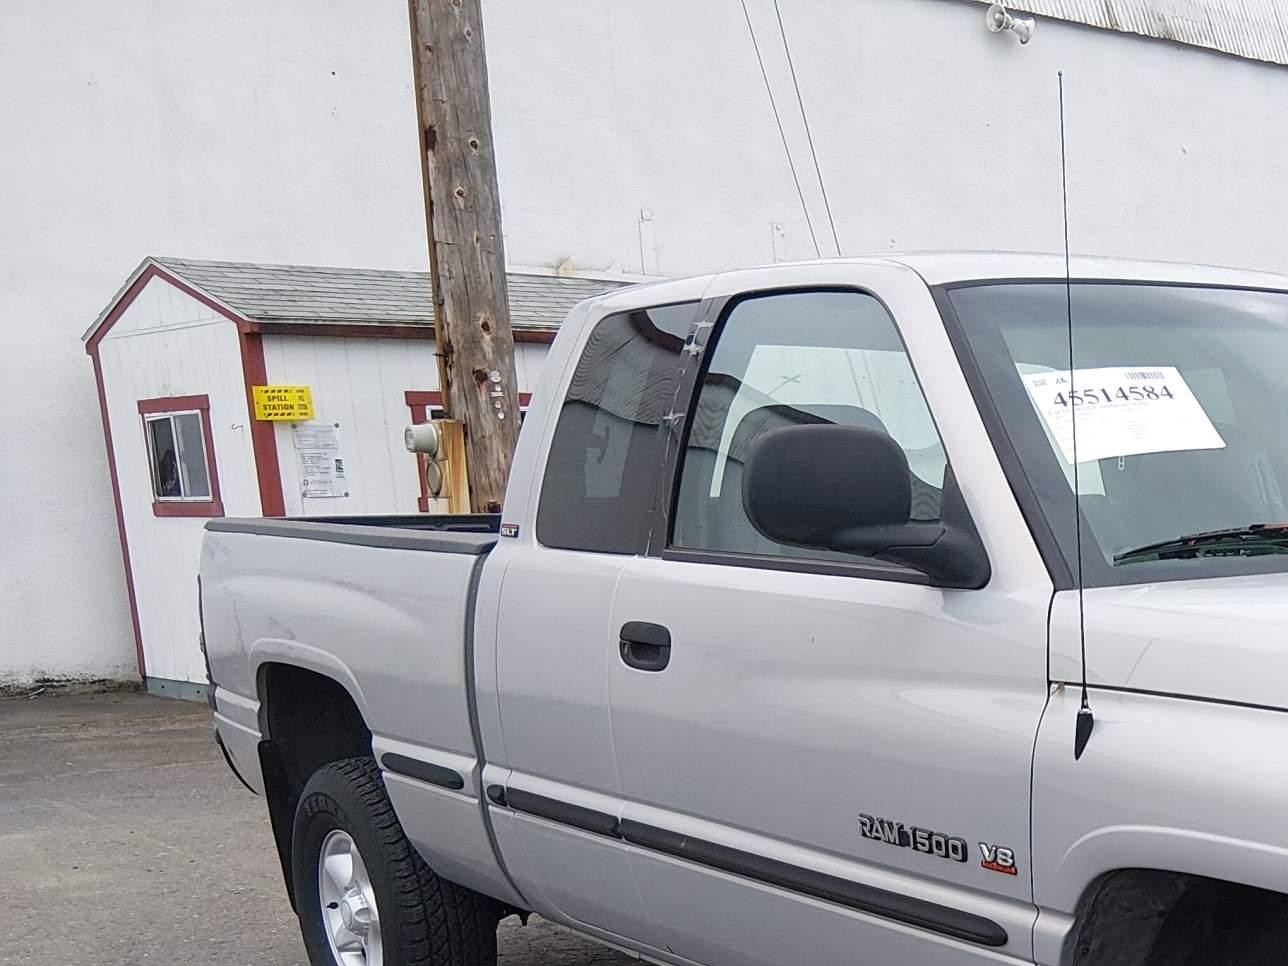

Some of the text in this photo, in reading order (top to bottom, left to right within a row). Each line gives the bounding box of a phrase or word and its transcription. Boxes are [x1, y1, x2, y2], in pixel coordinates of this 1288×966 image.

[1053, 384, 1175, 408] 45514584
[263, 403, 295, 411] STATION
[501, 527, 518, 537] SLT
[858, 813, 1015, 867] RAM 1500 V8
